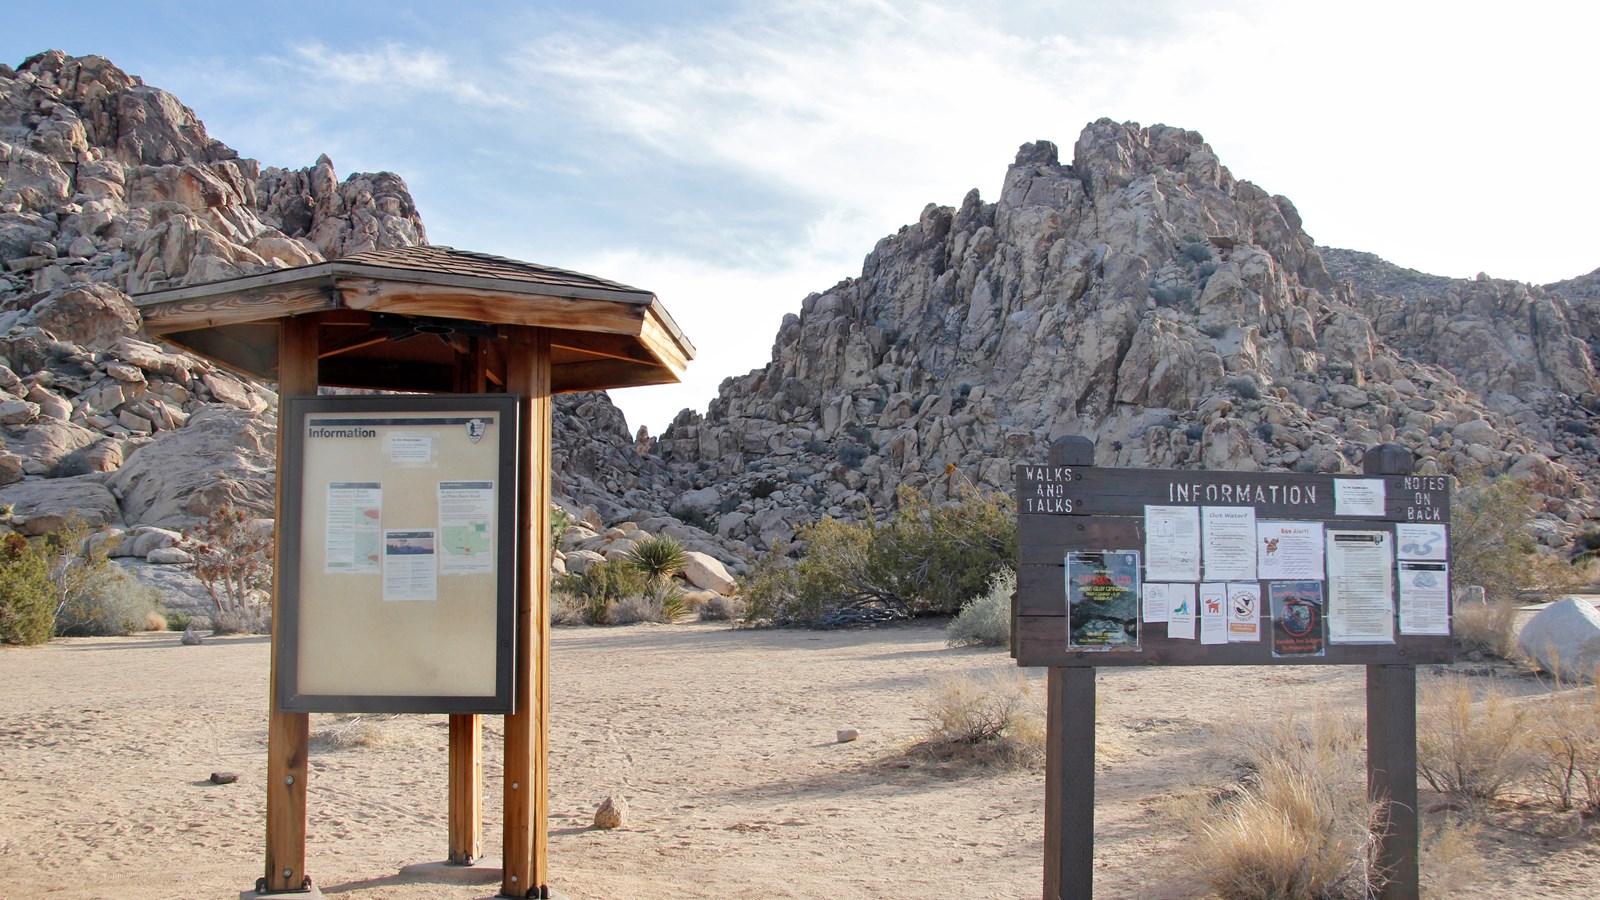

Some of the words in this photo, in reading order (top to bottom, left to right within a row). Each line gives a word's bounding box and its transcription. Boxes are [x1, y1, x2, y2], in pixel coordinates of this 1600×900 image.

[309, 428, 376, 438] Information
[1026, 467, 1072, 481] WALKS
[1404, 476, 1444, 490] NOTES
[1037, 484, 1064, 497] AND
[1169, 482, 1316, 504] INFORMATION
[1415, 492, 1431, 505] ON
[1026, 499, 1073, 513] TALKS
[1407, 506, 1441, 520] BACK
